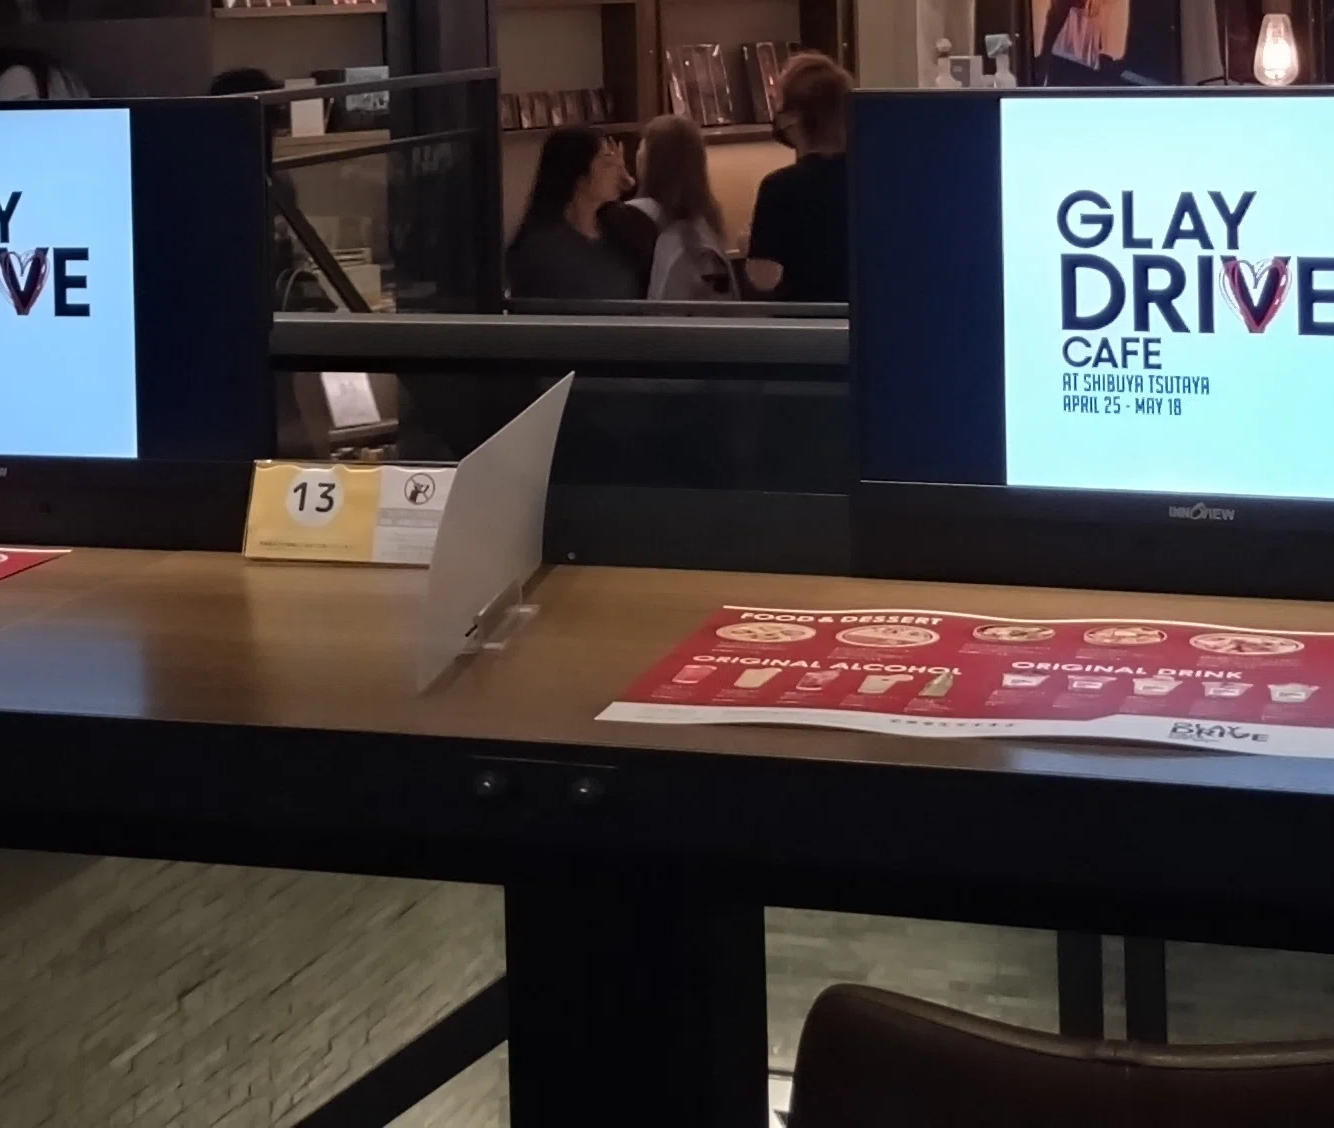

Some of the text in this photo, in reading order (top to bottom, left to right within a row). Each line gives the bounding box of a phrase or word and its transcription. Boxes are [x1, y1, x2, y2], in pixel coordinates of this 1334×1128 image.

[1056, 189, 1258, 250] GLAY
[1062, 336, 1162, 370] CAFE
[1063, 373, 1210, 395] AT SHIBUYA TSUTAYA
[1063, 395, 1100, 414] APRIL
[1104, 396, 1121, 414] 25
[1135, 397, 1163, 415] MAY
[1168, 398, 1182, 416] 18
[293, 482, 336, 513] 13
[740, 612, 815, 623] FOOD
[841, 615, 943, 626] DESSERT
[692, 654, 963, 676] ORIGINAL ALCOHOL
[1011, 660, 1244, 680] ORIGINAL DRINK
